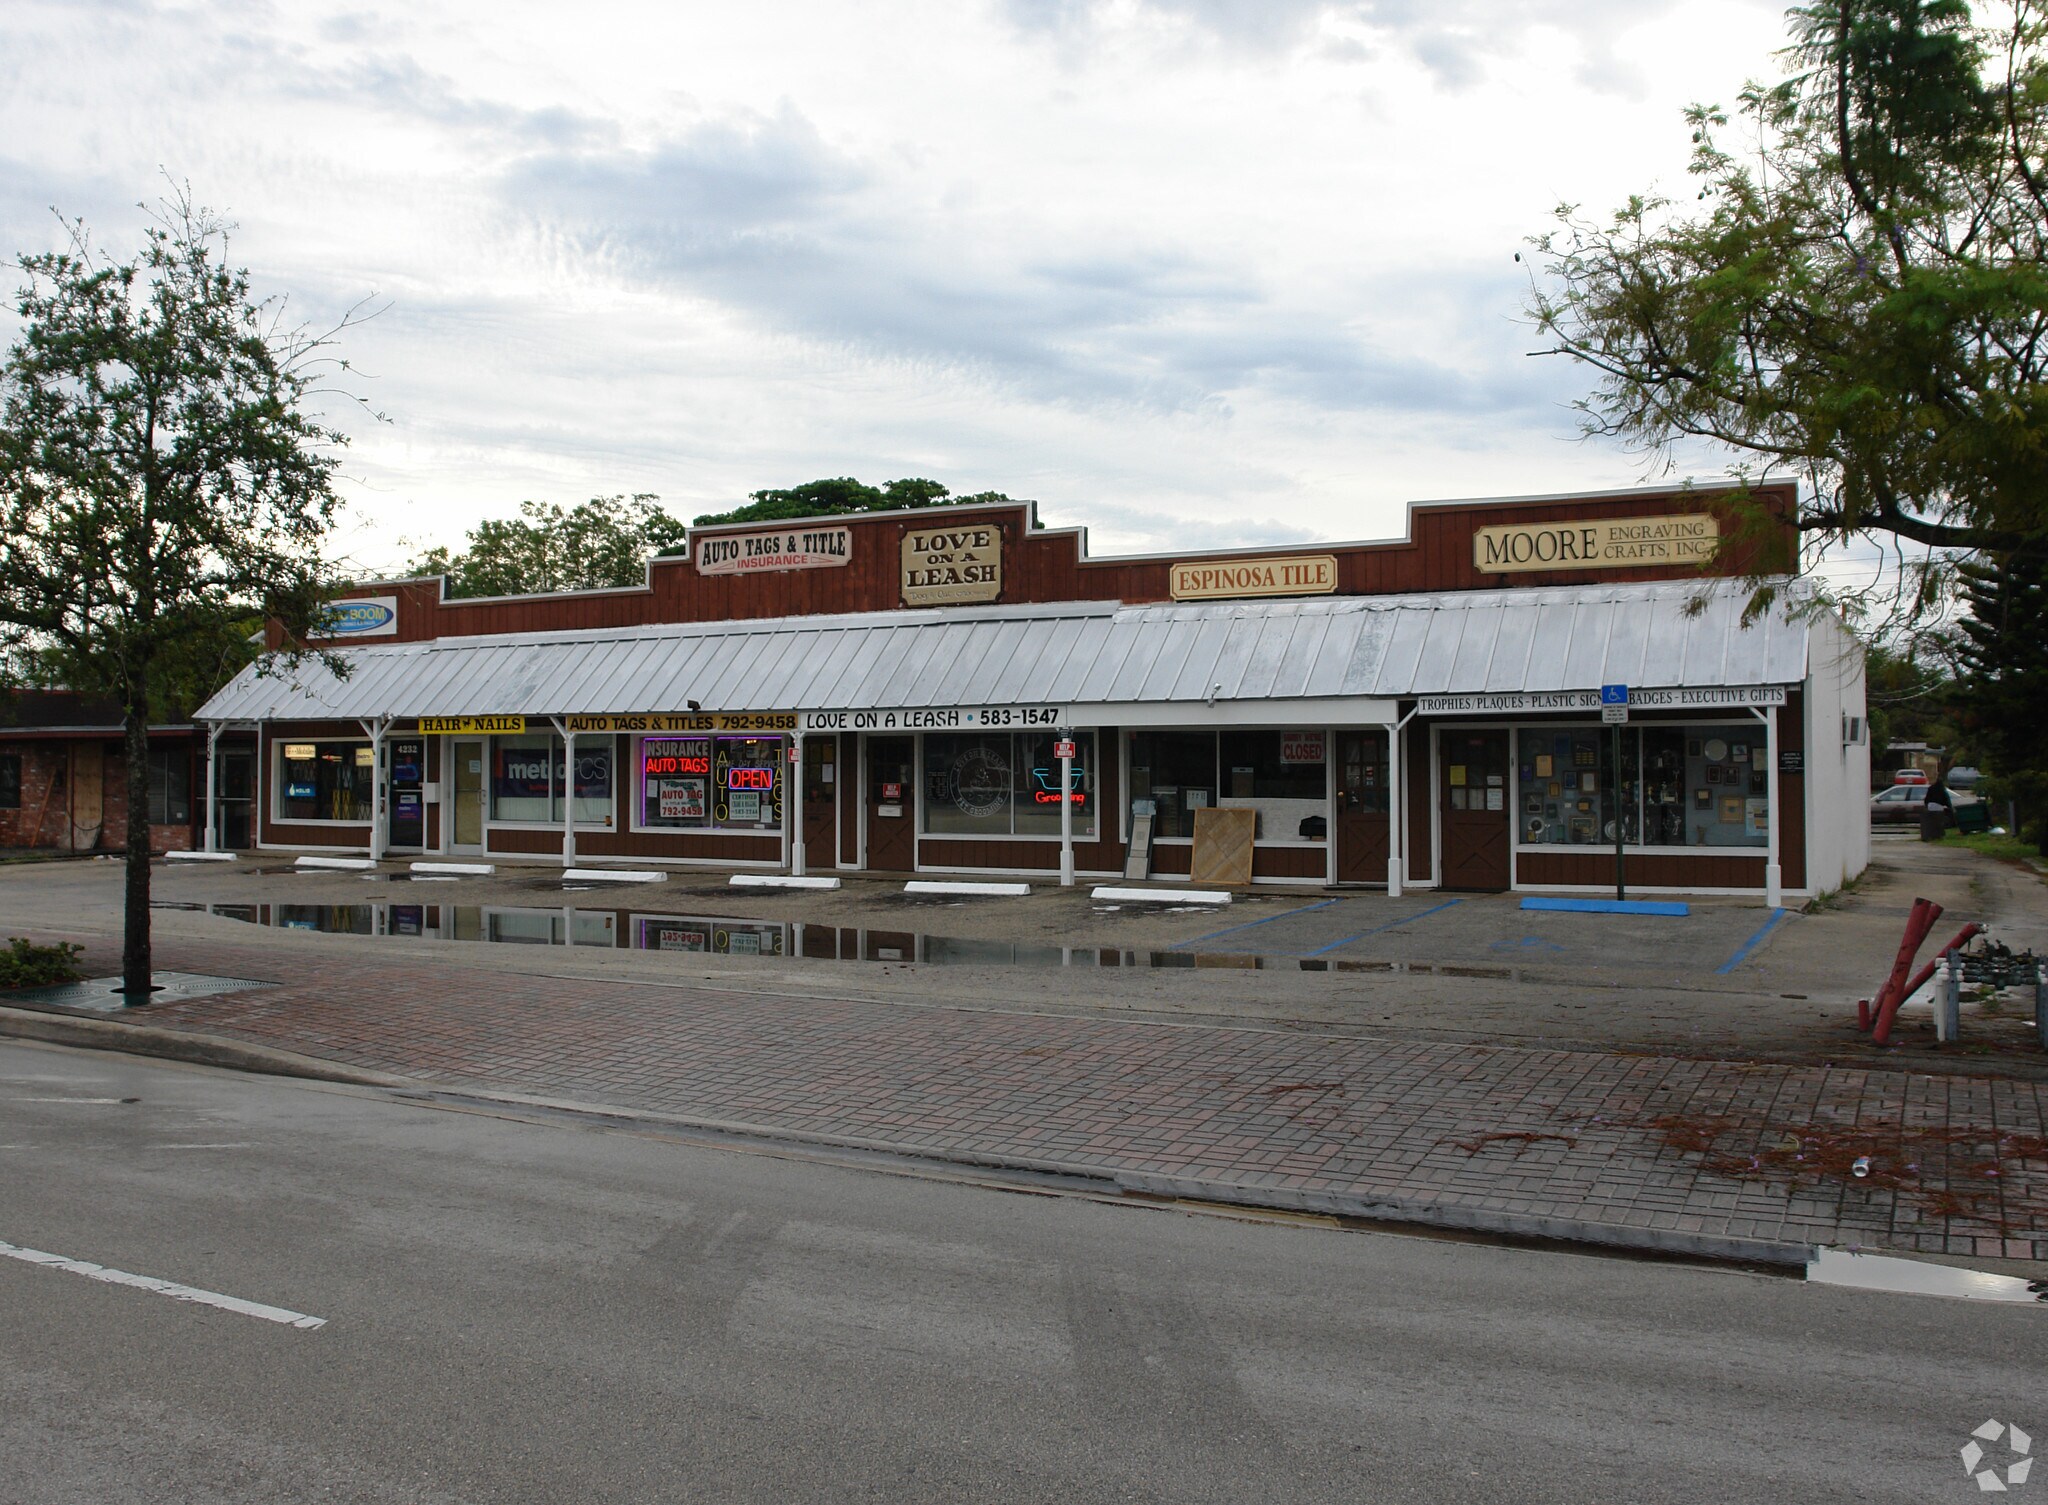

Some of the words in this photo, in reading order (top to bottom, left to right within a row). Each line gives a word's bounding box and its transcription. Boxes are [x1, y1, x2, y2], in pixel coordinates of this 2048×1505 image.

[1609, 522, 1705, 541] ENGRAVING
[702, 540, 739, 566] AUTO
[745, 536, 780, 556] TAGS
[786, 535, 796, 553] &
[803, 531, 846, 556] TITLE
[913, 531, 990, 552] LOVE
[1483, 528, 1600, 565] MOORE
[926, 553, 955, 565] ON
[959, 552, 981, 562] A
[1604, 543, 1670, 560] CRAFTS,
[737, 554, 808, 569] INSURANCE
[906, 564, 997, 588] LEASH
[1179, 566, 1276, 591] ESPINOSA
[1281, 563, 1329, 586] TILE
[1531, 694, 1576, 708] PLASTIC
[1681, 688, 1746, 703] EXECUTIVE
[1750, 688, 1784, 701] GIFTS
[423, 719, 462, 731] HAIR
[474, 718, 521, 730] NAILS
[569, 717, 607, 730] AUTO
[612, 717, 647, 730] TAGS
[651, 717, 663, 730] &
[666, 716, 714, 730] TITLES
[721, 716, 796, 729] 792-9458
[806, 713, 848, 729] LOVE
[854, 713, 878, 728] ON
[884, 712, 897, 728] A
[903, 711, 959, 728] LEASH
[980, 709, 1059, 725] 583-1547
[398, 745, 418, 753] 4232
[1283, 743, 1323, 760] CLOSED
[646, 758, 677, 772] AUTO
[679, 758, 709, 773] TAGS
[729, 769, 771, 788] OPEN
[661, 790, 684, 800] AUTO
[687, 789, 703, 800] TAG
[1035, 790, 1085, 807] Grooing
[662, 806, 703, 816] 792-9458
